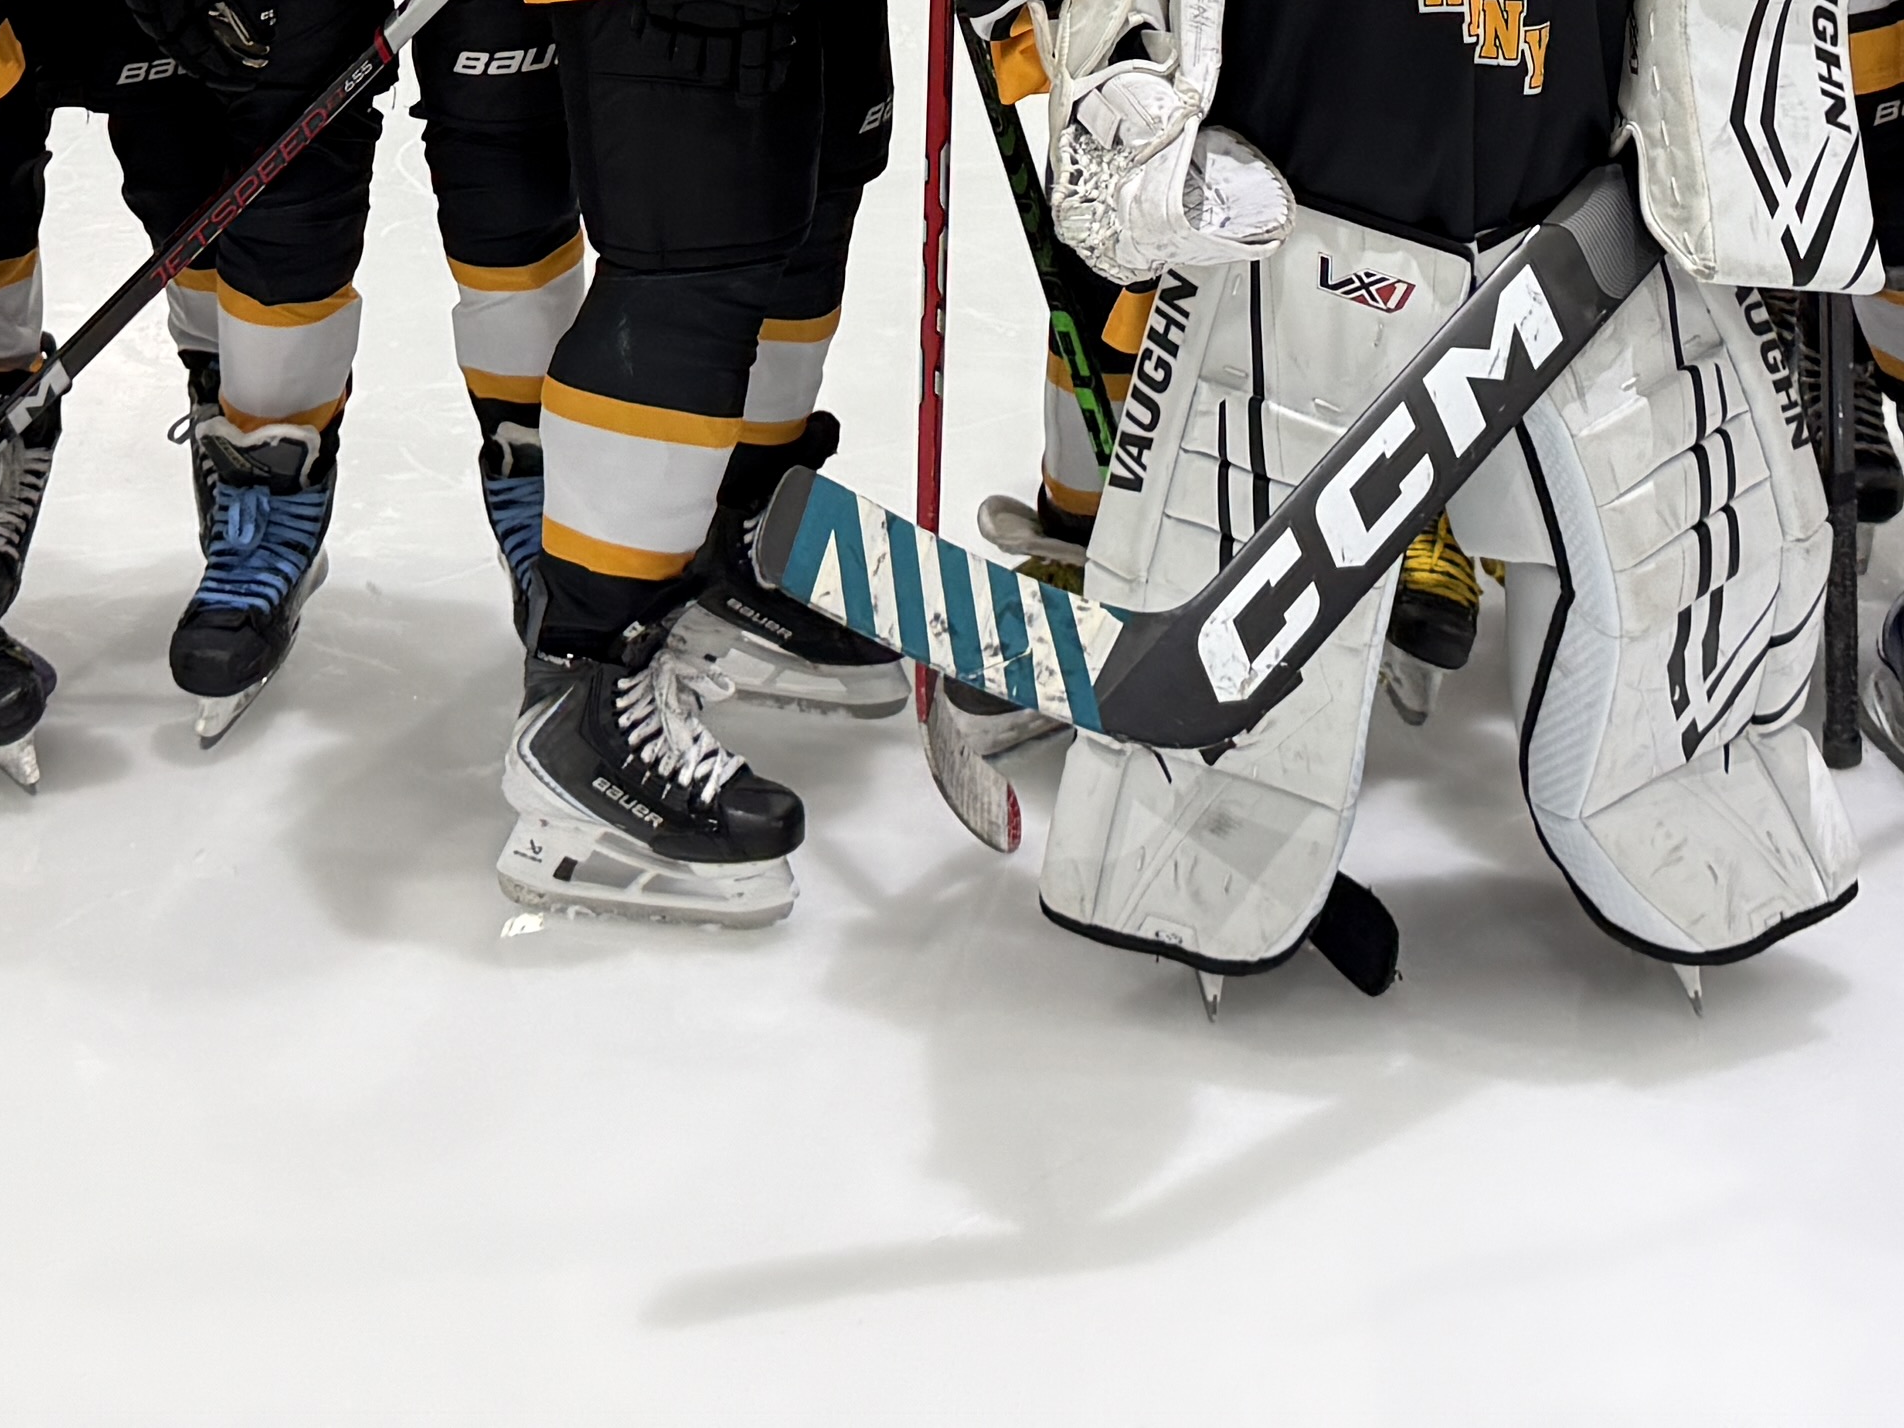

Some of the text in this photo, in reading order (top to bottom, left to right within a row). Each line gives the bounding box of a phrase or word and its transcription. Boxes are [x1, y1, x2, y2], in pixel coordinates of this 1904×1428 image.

[452, 43, 558, 76] BAU
[148, 106, 328, 289] JETSPEED
[1317, 252, 1417, 315] VX1
[1107, 268, 1200, 494] VAUGHN
[1197, 263, 1568, 705] CCM
[725, 597, 794, 641] BAUER
[591, 775, 665, 830] BAUER
